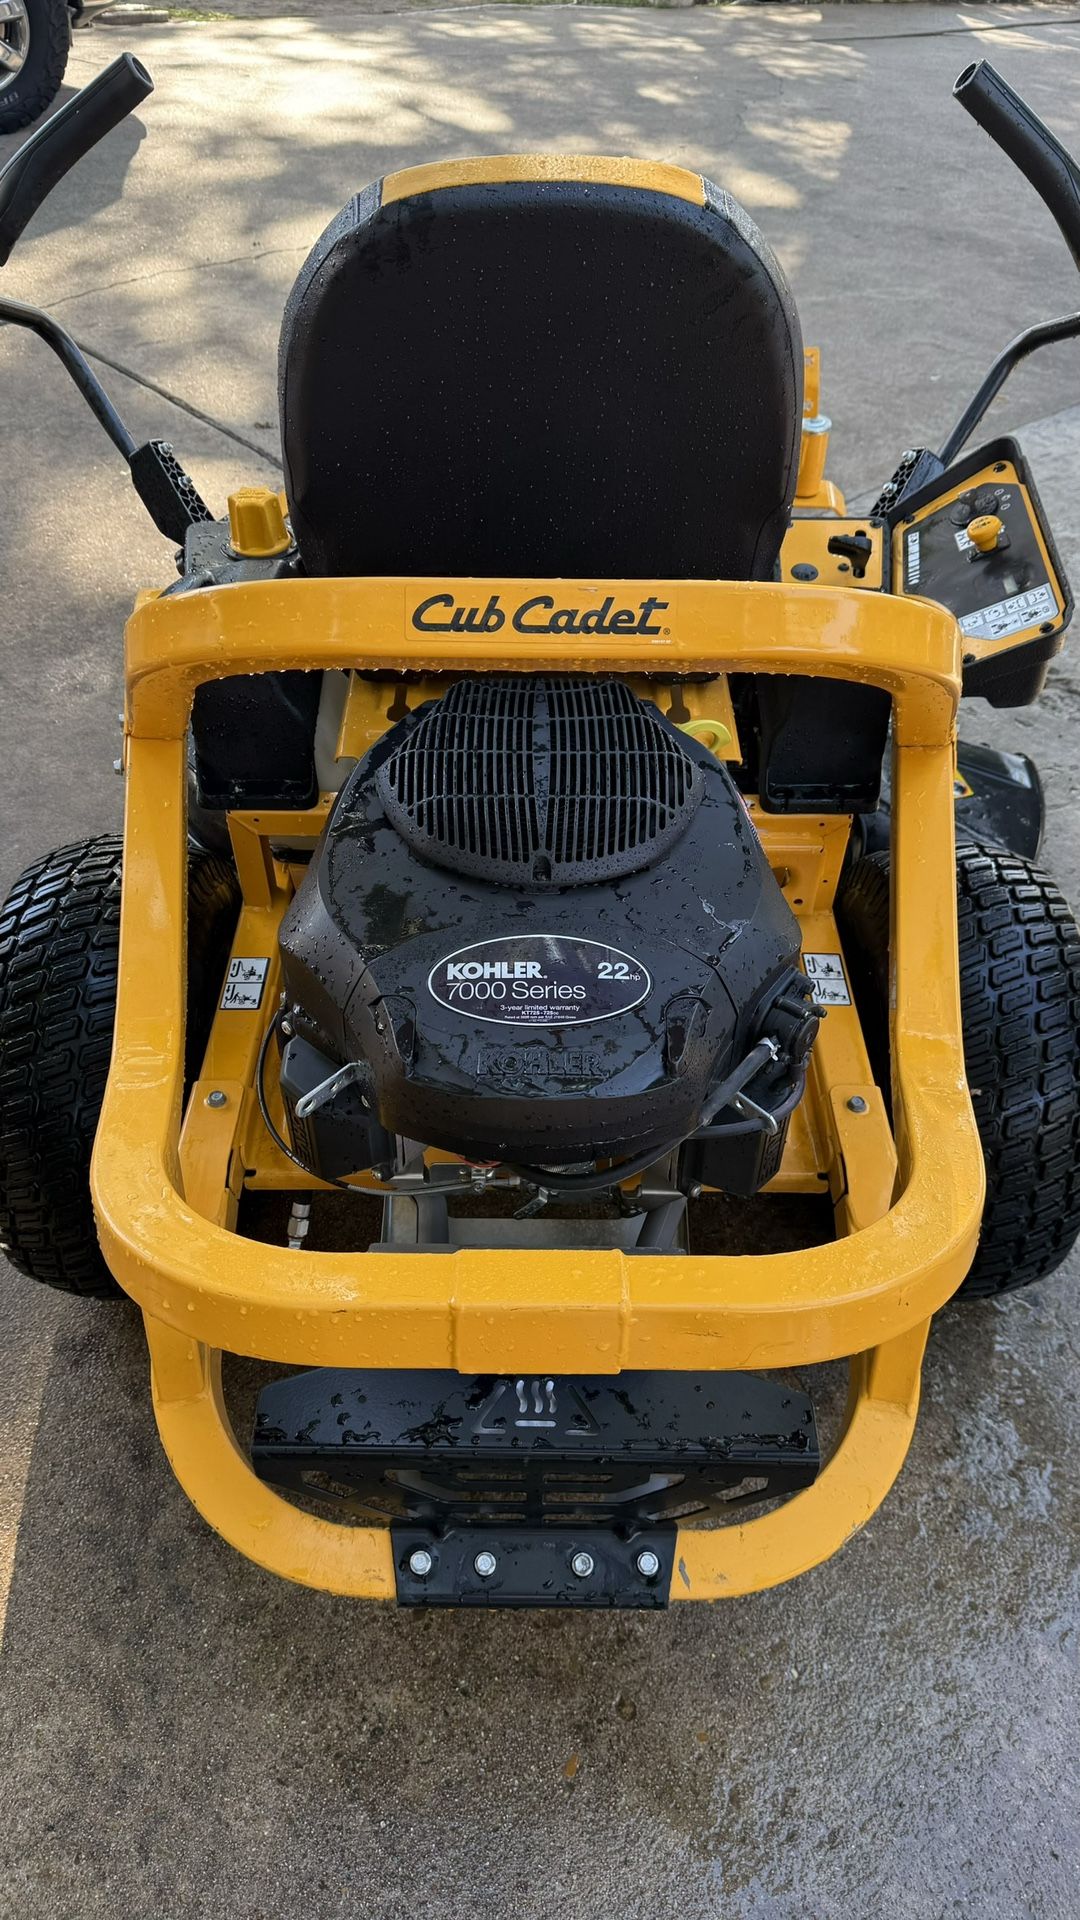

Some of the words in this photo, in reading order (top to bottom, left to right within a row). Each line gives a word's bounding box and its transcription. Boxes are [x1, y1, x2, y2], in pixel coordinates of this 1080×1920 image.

[412, 593, 506, 633] Cub
[446, 981, 507, 1000] 7000
[511, 980, 587, 1000] Series
[500, 1004, 523, 1012] 3-year
[549, 1004, 580, 1012] warranty
